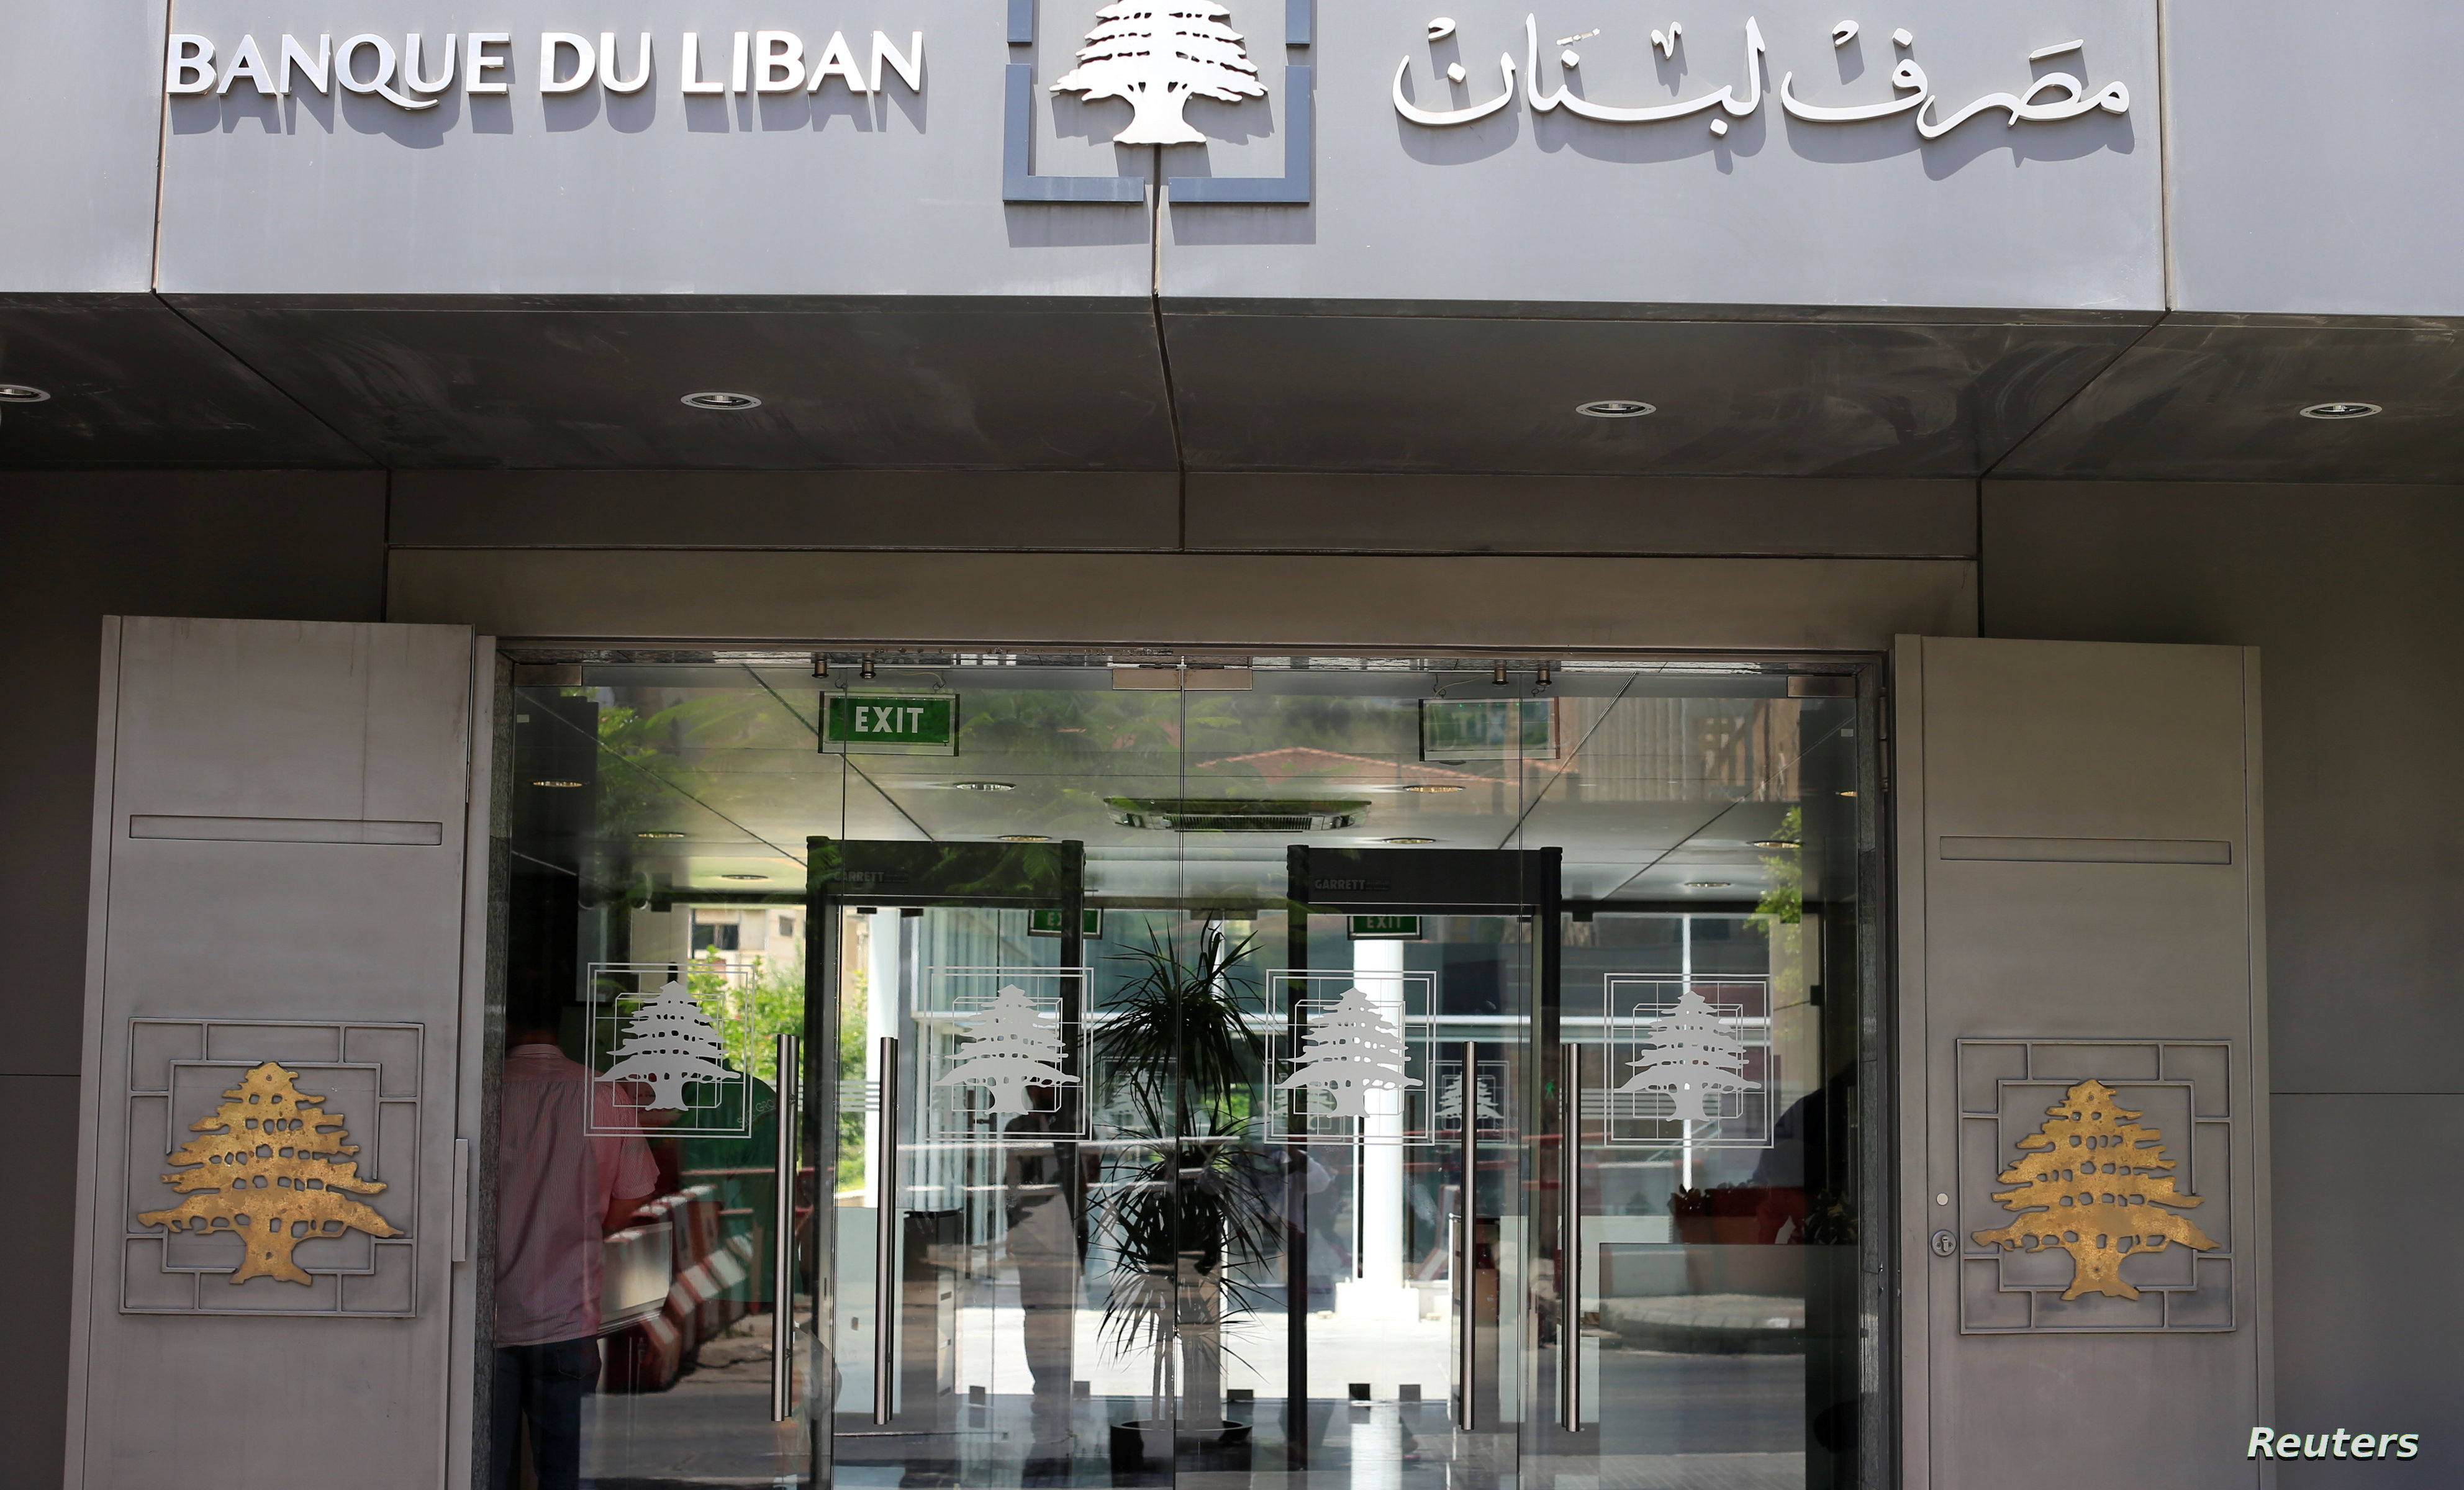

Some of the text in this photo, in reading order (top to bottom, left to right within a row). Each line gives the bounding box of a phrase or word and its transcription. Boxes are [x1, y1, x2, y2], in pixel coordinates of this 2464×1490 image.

[166, 30, 923, 111] BANQUE DU LIBAN
[855, 706, 924, 733] EXIT
[1315, 879, 1366, 890] GARRETT
